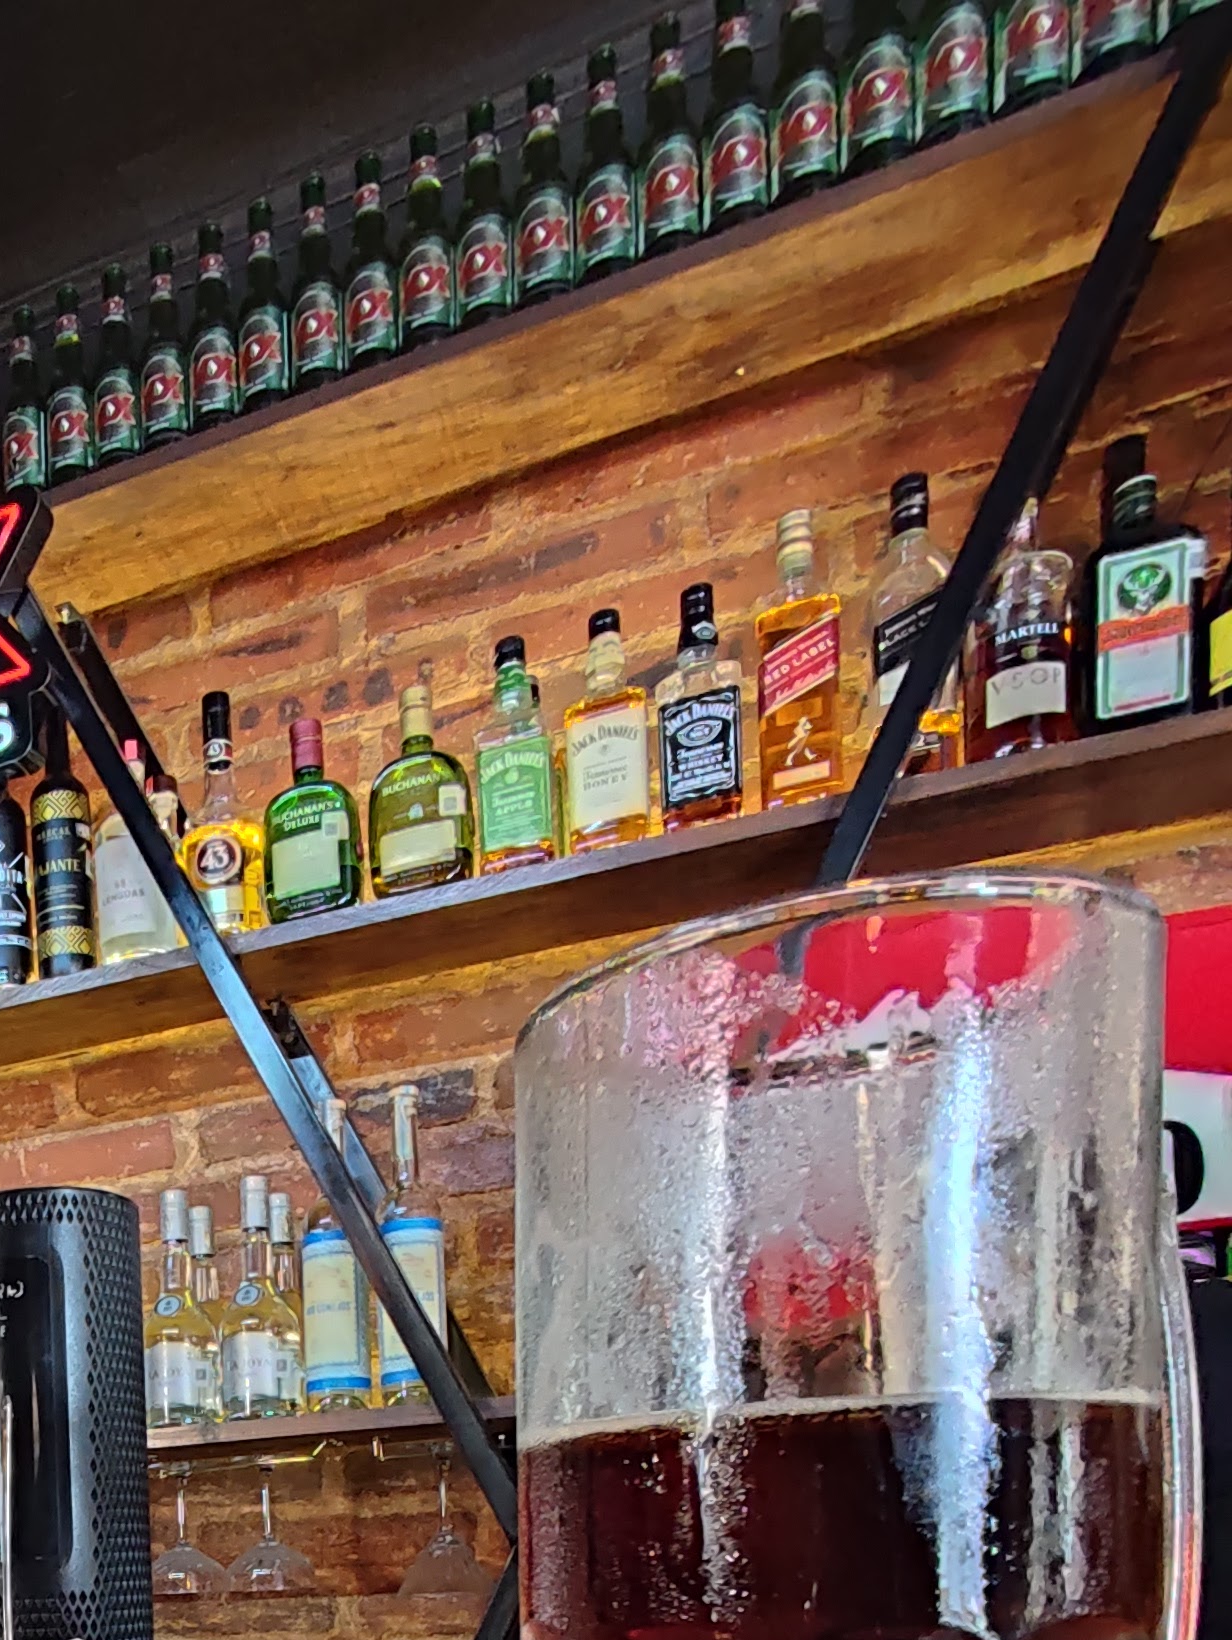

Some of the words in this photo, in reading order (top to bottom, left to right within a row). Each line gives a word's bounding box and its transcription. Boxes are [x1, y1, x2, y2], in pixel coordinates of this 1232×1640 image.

[995, 622, 1059, 646] MARTELL
[763, 661, 791, 686] RED
[793, 636, 836, 667] LABEL
[665, 711, 692, 736] JACK
[692, 702, 735, 720] DANIEL'S
[572, 736, 598, 757] JACK
[597, 724, 639, 742] DANIEL'S
[481, 758, 505, 784] JACK
[504, 751, 545, 768] DANIEL'S
[284, 815, 320, 832] DELUXE
[200, 844, 230, 870] 43
